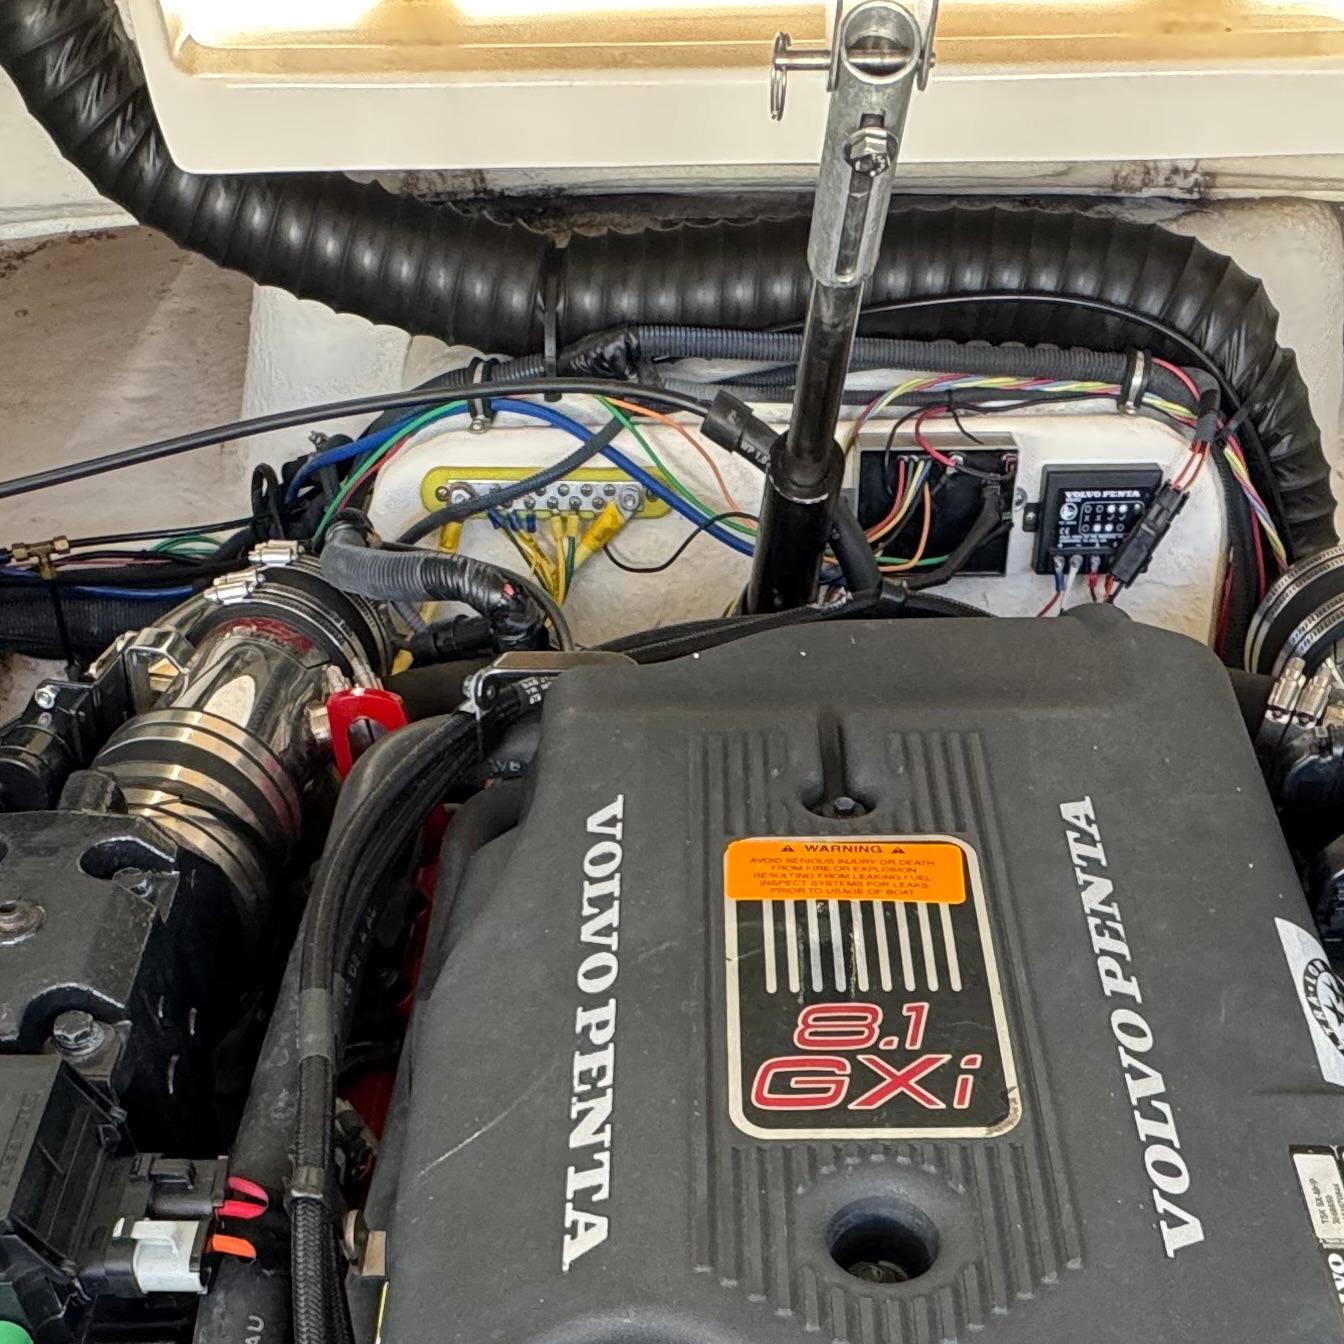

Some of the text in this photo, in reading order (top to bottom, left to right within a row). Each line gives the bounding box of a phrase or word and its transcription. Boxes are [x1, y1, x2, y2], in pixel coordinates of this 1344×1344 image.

[1102, 490, 1141, 498] PENTA
[805, 844, 882, 854] WARNING
[838, 858, 875, 866] INJURY
[853, 866, 917, 874] EXPLOSION
[854, 873, 901, 881] LEAKING
[792, 1001, 930, 1051] 8.1
[1059, 796, 1206, 1257] VOLVO PENTA
[562, 795, 624, 1271] VOLVO PENTA
[749, 1053, 982, 1110] GXi
